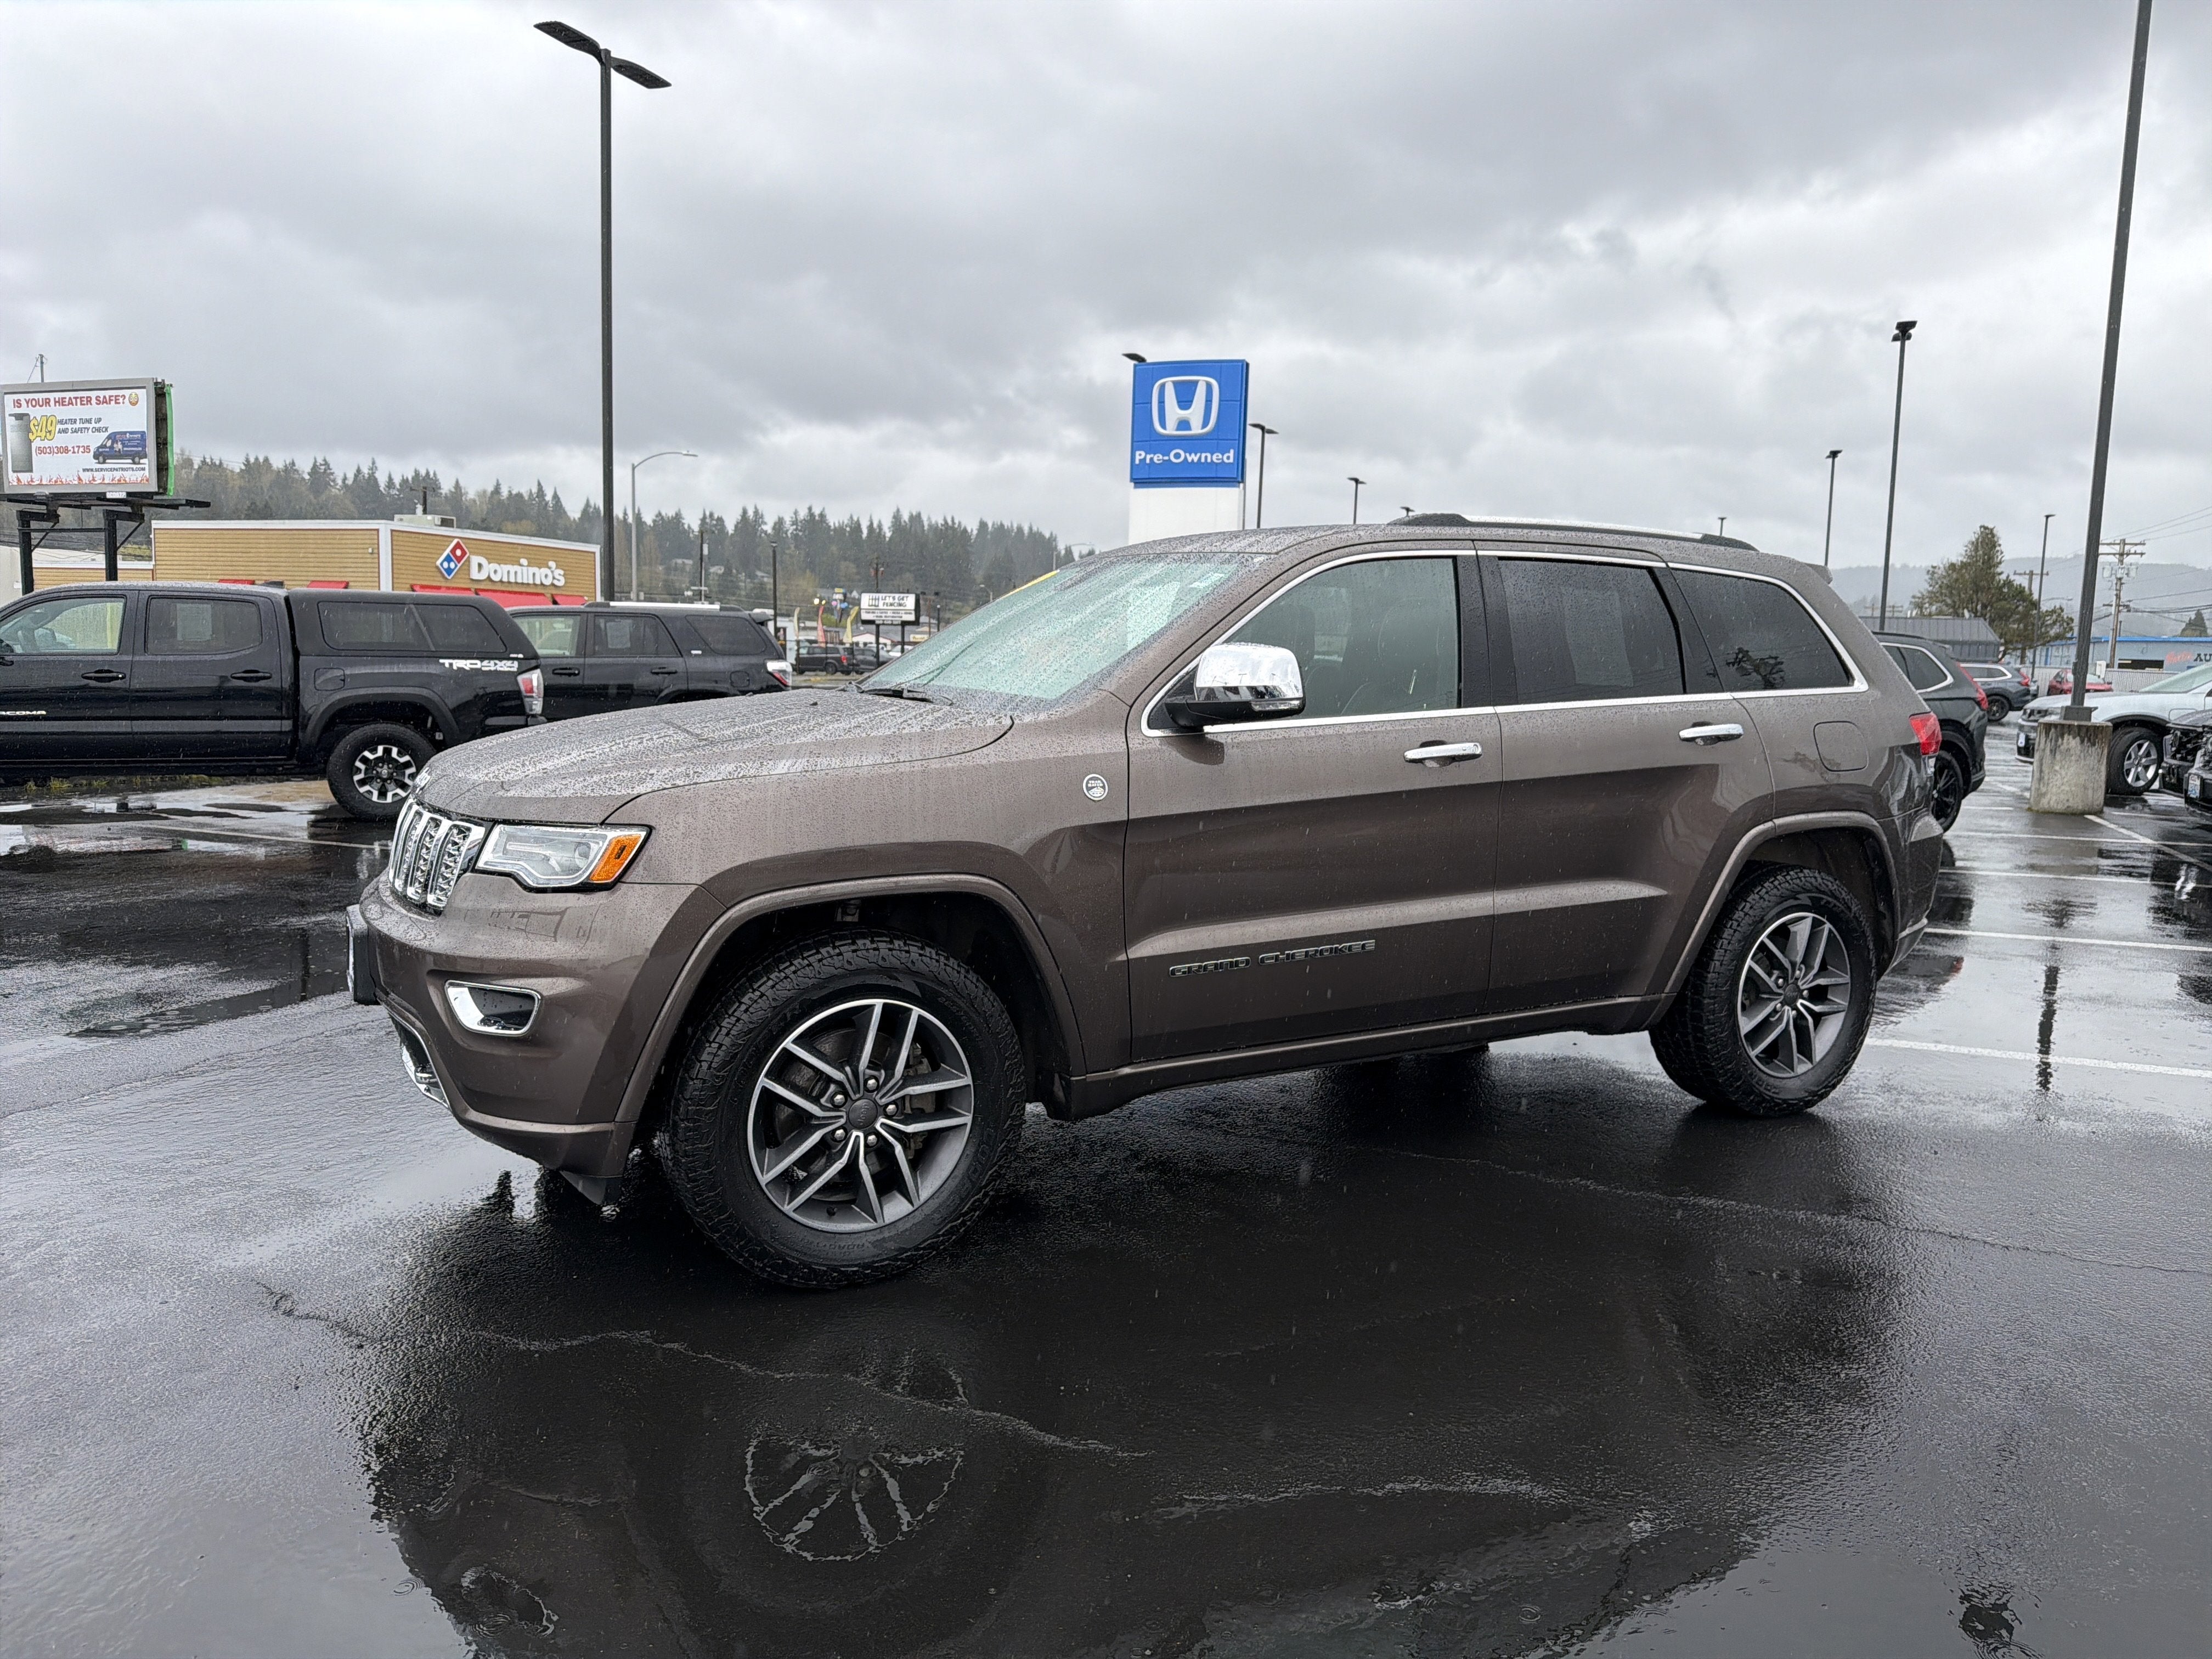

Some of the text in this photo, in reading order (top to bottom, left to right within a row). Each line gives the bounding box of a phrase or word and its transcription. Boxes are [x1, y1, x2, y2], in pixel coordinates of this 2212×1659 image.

[13, 394, 126, 408] IS YOUR HEATER SAFE?
[29, 415, 57, 443] $49
[35, 445, 91, 456] (503)308-1735
[1135, 449, 1234, 465] Pre-Owned
[470, 555, 566, 586] Domino's
[1169, 940, 1376, 977] GRAND CHEROKEE
